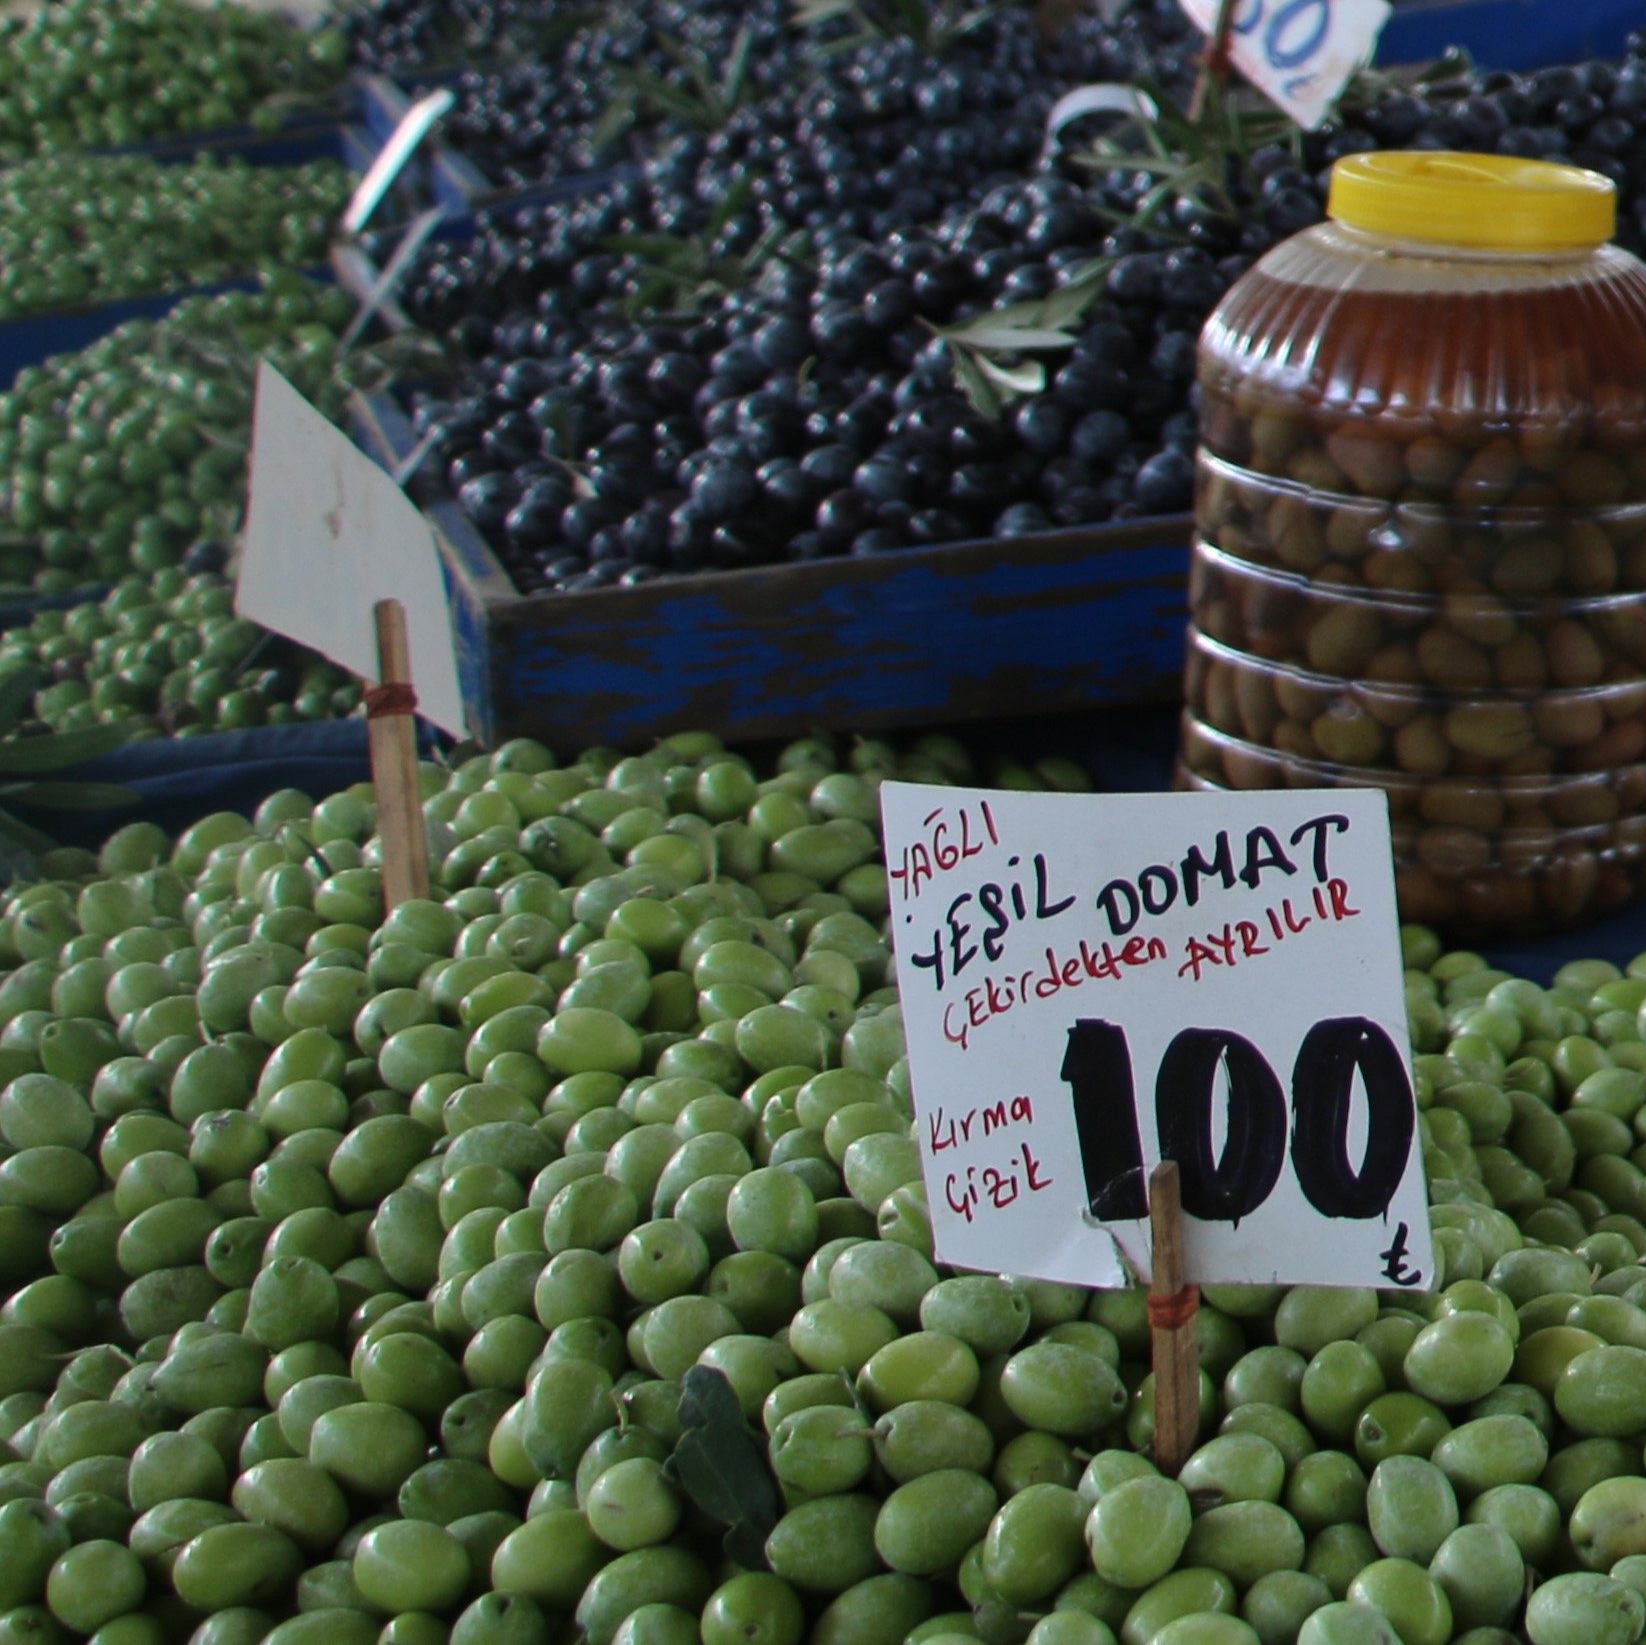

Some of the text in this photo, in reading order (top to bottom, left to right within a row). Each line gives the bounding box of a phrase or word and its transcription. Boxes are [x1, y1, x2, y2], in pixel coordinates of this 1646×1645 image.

[889, 799, 999, 901] YAĞLI
[1096, 813, 1350, 936] DOMAT
[1178, 877, 1361, 981] AYRILIR
[1060, 1016, 1416, 1226] 100
